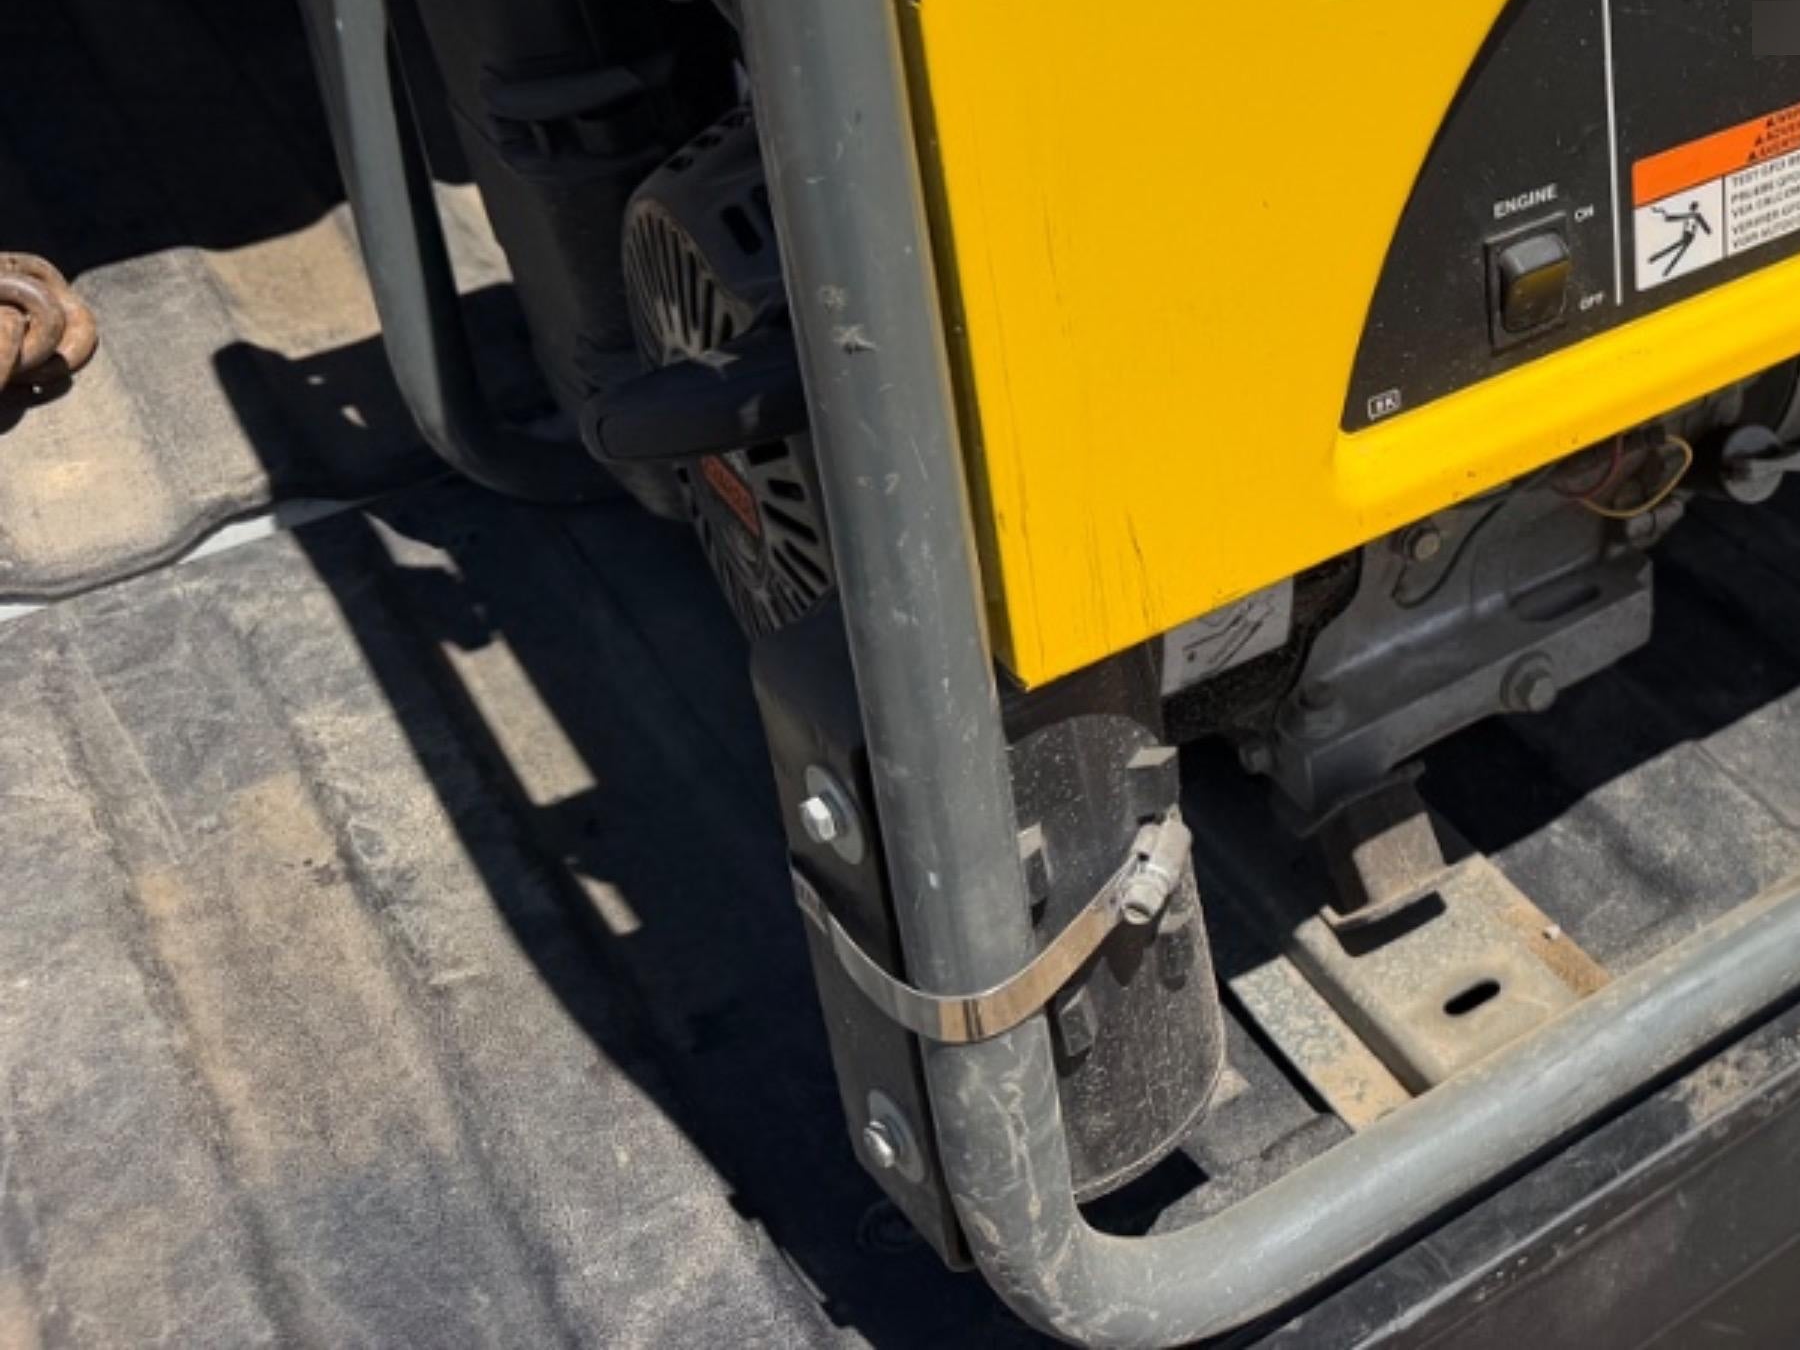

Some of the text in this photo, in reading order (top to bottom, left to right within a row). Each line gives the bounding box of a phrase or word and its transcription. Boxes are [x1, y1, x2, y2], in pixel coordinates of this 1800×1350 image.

[1493, 182, 1559, 220] ENGINE
[1573, 203, 1595, 224] ON
[1578, 290, 1606, 311] OFF
